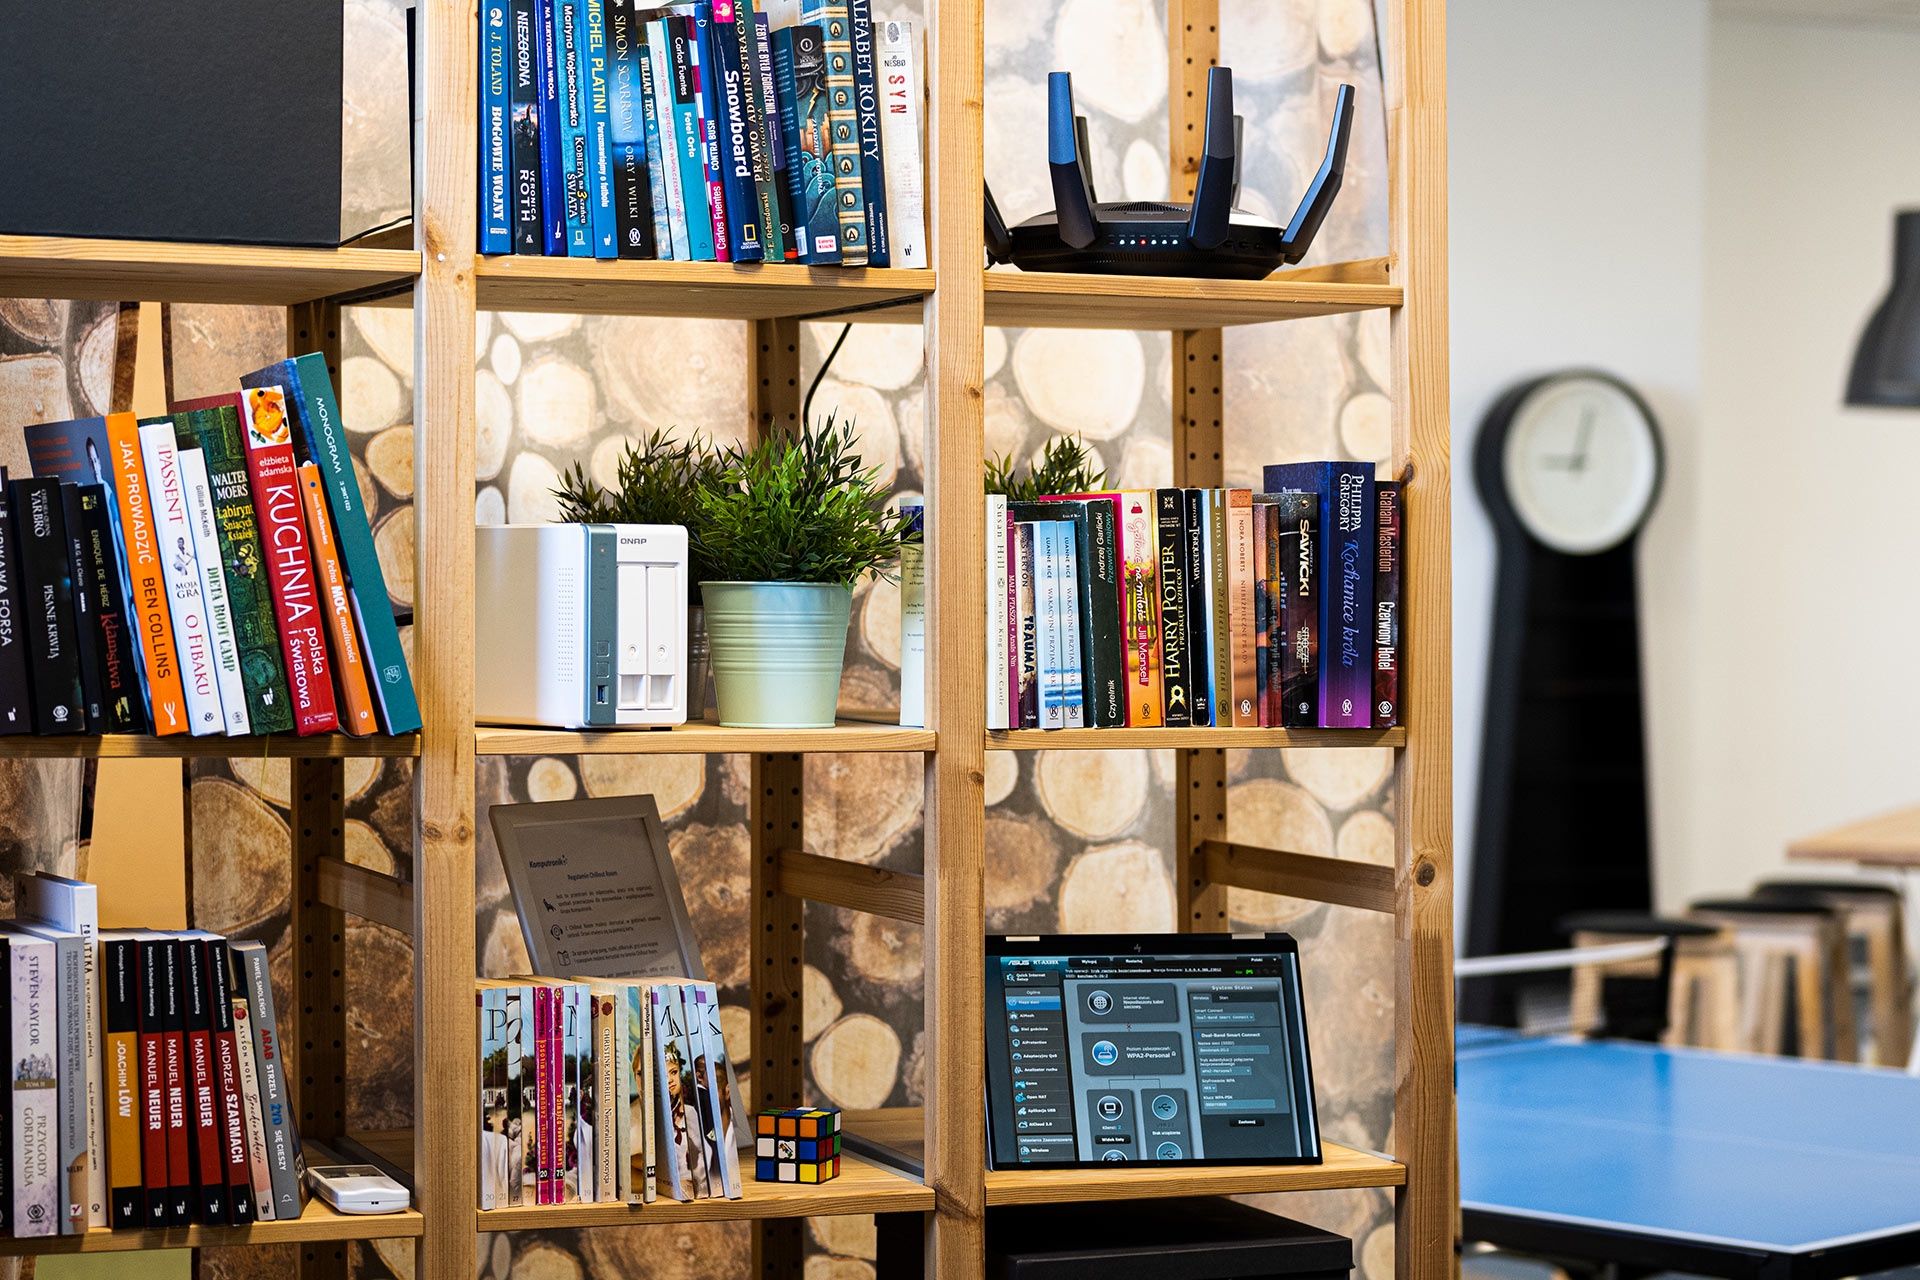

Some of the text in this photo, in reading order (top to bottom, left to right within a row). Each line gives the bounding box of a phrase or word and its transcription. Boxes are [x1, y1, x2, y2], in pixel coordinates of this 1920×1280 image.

[516, 10, 531, 88] NIEZGODNA
[545, 20, 555, 100] TERYTORIUM WROGA
[588, 0, 606, 113] MICHEL PLATINI
[755, 24, 767, 42] ŻEBY
[758, 42, 768, 53] NIE
[758, 54, 770, 72] BYŁO
[884, 59, 906, 67] NESBØ
[491, 46, 502, 95] TOLAND
[563, 5, 578, 127] Martyna Wojciechowska
[614, 15, 633, 133] SIMON SCARROW
[640, 56, 655, 121] WILLIAM TENN
[674, 37, 688, 96] Carlos Fuentes
[761, 72, 776, 115] ZGORSZENIA
[853, 0, 879, 161] ALFABET ROKITY
[888, 75, 907, 114] SYN
[491, 106, 503, 171] BOGOWIE
[684, 112, 694, 135] Fotel
[706, 120, 720, 171] CONTRA BUSH
[724, 70, 750, 177] Snowboard
[574, 136, 585, 178] KOBIETA
[597, 121, 610, 208] Porozmawiajmy futbolu
[624, 146, 638, 219] ORŁY WILKI
[750, 131, 763, 182] PRAWO
[492, 175, 504, 221] WOJNY
[519, 169, 531, 222] ROTH
[529, 170, 537, 222] VERONICA
[566, 173, 579, 218] ŚWIATA
[713, 185, 727, 250] Carlos Fuentes
[764, 192, 774, 238] Ochendowski
[316, 396, 342, 474] MONOGRAM
[158, 449, 183, 525] PASSENT
[211, 471, 247, 487] WALTER
[216, 484, 248, 500] MOERS
[259, 465, 292, 477] adamska
[30, 490, 46, 538] YARBRO
[120, 440, 154, 564] JAK PROWADZIĆ
[195, 484, 211, 538] Gillian McKeith
[216, 504, 254, 519] Labirynt
[1339, 472, 1352, 533] GREGORY
[1351, 474, 1365, 532] PHILIPPA
[1379, 490, 1396, 572] Graham Masterton
[91, 529, 110, 608] ENRIQUE DE HÉRIZ
[996, 503, 1005, 647] Susan Hill King
[1045, 537, 1053, 563] LUANNE
[1063, 537, 1071, 563] LUANNE
[1096, 512, 1107, 580] Andrzej Garlicki
[1105, 511, 1115, 584] Przewrót majowy
[1127, 518, 1147, 622] Gotowe miłość
[1188, 526, 1200, 581] TORQUEMADA
[1299, 519, 1310, 597] SAWICKI
[175, 581, 197, 591] MOJA
[176, 589, 200, 600] GRA
[266, 485, 313, 622] KUCHNIA
[303, 626, 325, 675] polska
[1162, 543, 1177, 611] POTTER
[1340, 539, 1360, 669] Kochanice króla
[0, 599, 13, 647] FORSA
[43, 584, 60, 659] PISANE KRWIĄ
[143, 577, 171, 679] BEN COLLINS
[207, 566, 235, 672] DIETA BOOT CAMP
[325, 558, 356, 663] Pełna MOC możliwości
[1047, 587, 1056, 633] WAKACYJNE
[1066, 587, 1075, 632] WAKACYJNE
[1176, 604, 1184, 646] PRZEKLĘTE
[1240, 580, 1248, 638] NIEBEZPIECZNE
[1377, 601, 1395, 671] Czerwony Hotel
[185, 614, 210, 696] O FIBAKU
[289, 637, 312, 709] światowa
[1023, 615, 1035, 674] TRAUMA
[1137, 626, 1149, 683] Jill Mansell
[1163, 617, 1180, 679] HARRY
[1300, 626, 1310, 664] SMOCZE
[1107, 679, 1117, 719] Czytelnik
[529, 857, 563, 868] Komputronik
[81, 924, 92, 974] POLITYKA
[28, 955, 41, 1046] STEVEN SAYLOR
[253, 957, 268, 1018] PAWEŁ SMOLEŃSKI
[239, 1024, 248, 1057] ALYSON
[1126, 1051, 1171, 1059] WPA2-Personal
[116, 1040, 132, 1118] JOACHIM LÖW
[146, 1041, 162, 1130] MANUEL NEUER
[167, 1039, 182, 1128] MANUEL NEUER
[194, 1038, 213, 1127] MANUEL NEUER
[220, 1039, 244, 1164] ANDRZEJ SZARMACH
[261, 1028, 287, 1171] ARAB STRZELA ŻYD SIĘ CIESZY
[603, 1028, 612, 1184] CHRISTINE MERRILL Niemoralna propozycja
[23, 1107, 35, 1188] GORDIANUSA
[36, 1115, 47, 1178] PRZYGODY
[539, 1169, 548, 1178] 20
[555, 1169, 564, 1178] 75
